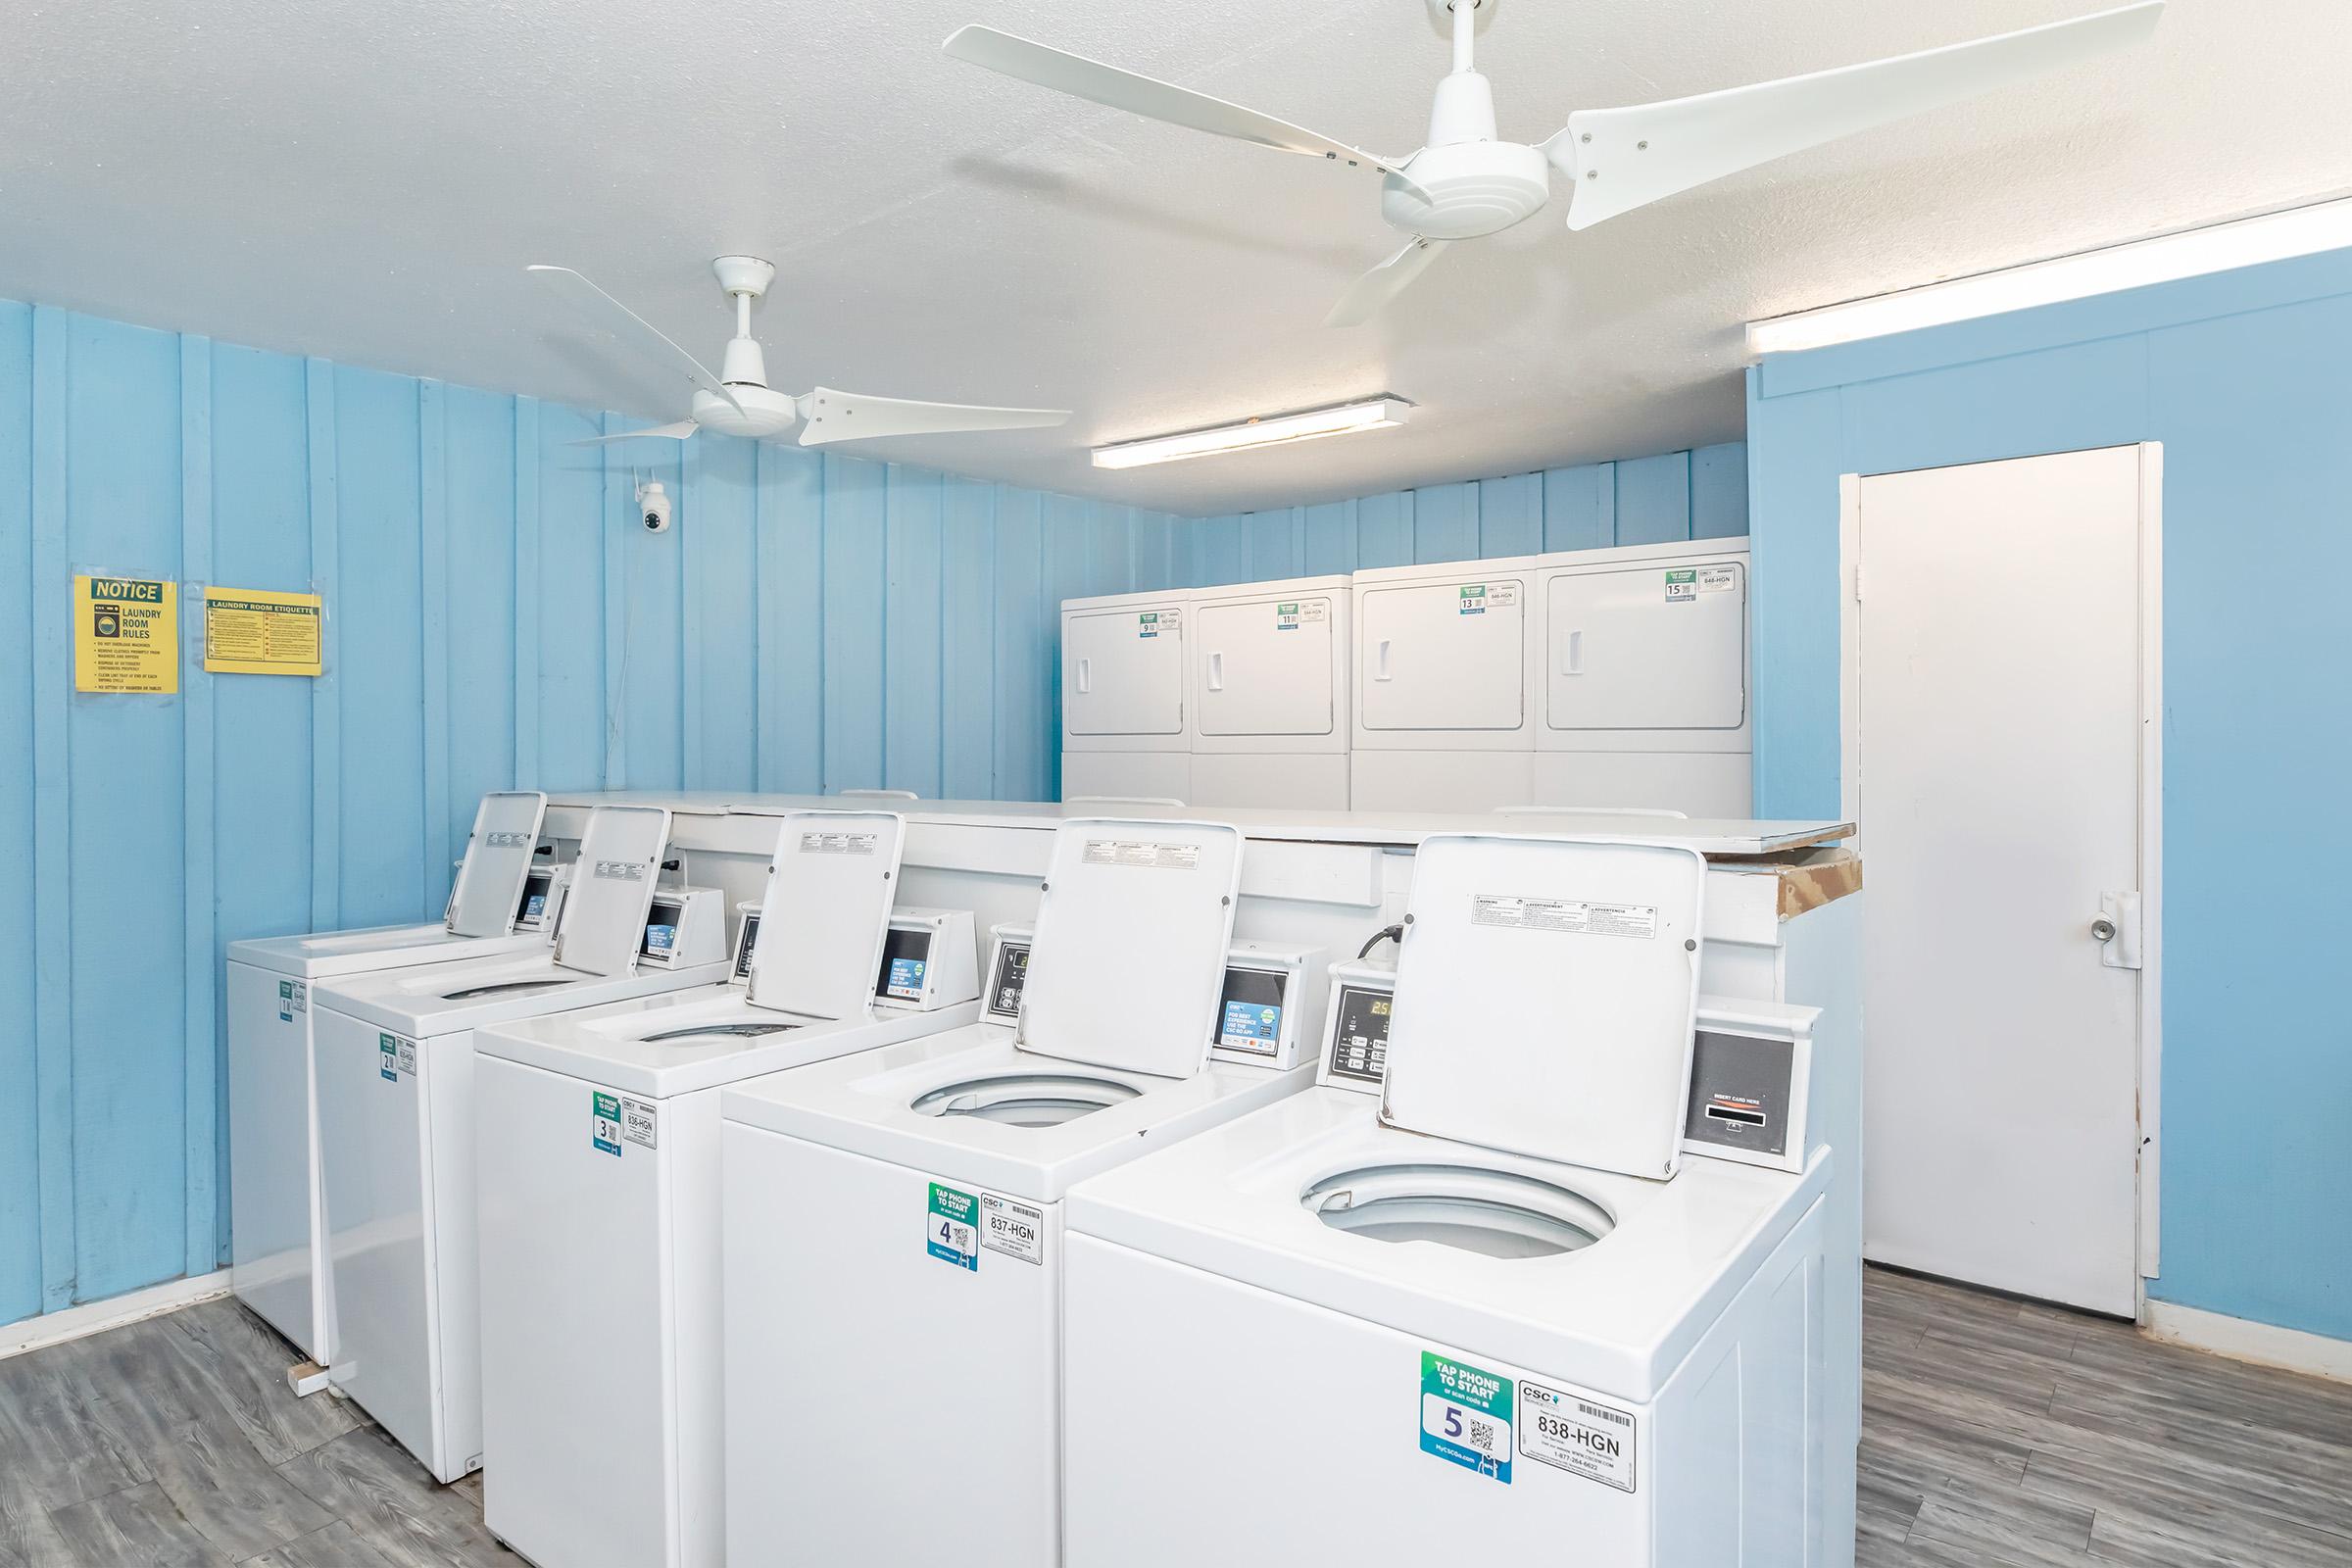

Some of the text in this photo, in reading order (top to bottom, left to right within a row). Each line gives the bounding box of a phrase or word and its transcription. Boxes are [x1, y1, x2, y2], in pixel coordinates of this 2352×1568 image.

[96, 581, 157, 599] NOTICE
[1668, 585, 1680, 594] 15
[212, 601, 249, 609] LAUNDRY
[275, 606, 313, 614] ETIQUETTE
[1463, 599, 1472, 608] 13
[122, 608, 161, 619] LAUNDRY
[122, 619, 148, 628] ROOM
[122, 630, 150, 638] RULES
[385, 1055, 389, 1068] 2
[600, 1120, 606, 1137] 3
[936, 1188, 971, 1207] TAP PHONE
[938, 1197, 968, 1213] TO START
[983, 1197, 998, 1207] CSC
[940, 1221, 951, 1243] 4
[990, 1217, 1034, 1241] 837-HGN
[1435, 1361, 1500, 1392] TAP PHONE
[1440, 1373, 1495, 1400] TO START
[1523, 1387, 1551, 1401] CSC
[1452, 1390, 1465, 1400] scan
[1465, 1396, 1481, 1405] code
[1444, 1406, 1462, 1437] 5
[1538, 1416, 1619, 1457] 838-HGN
